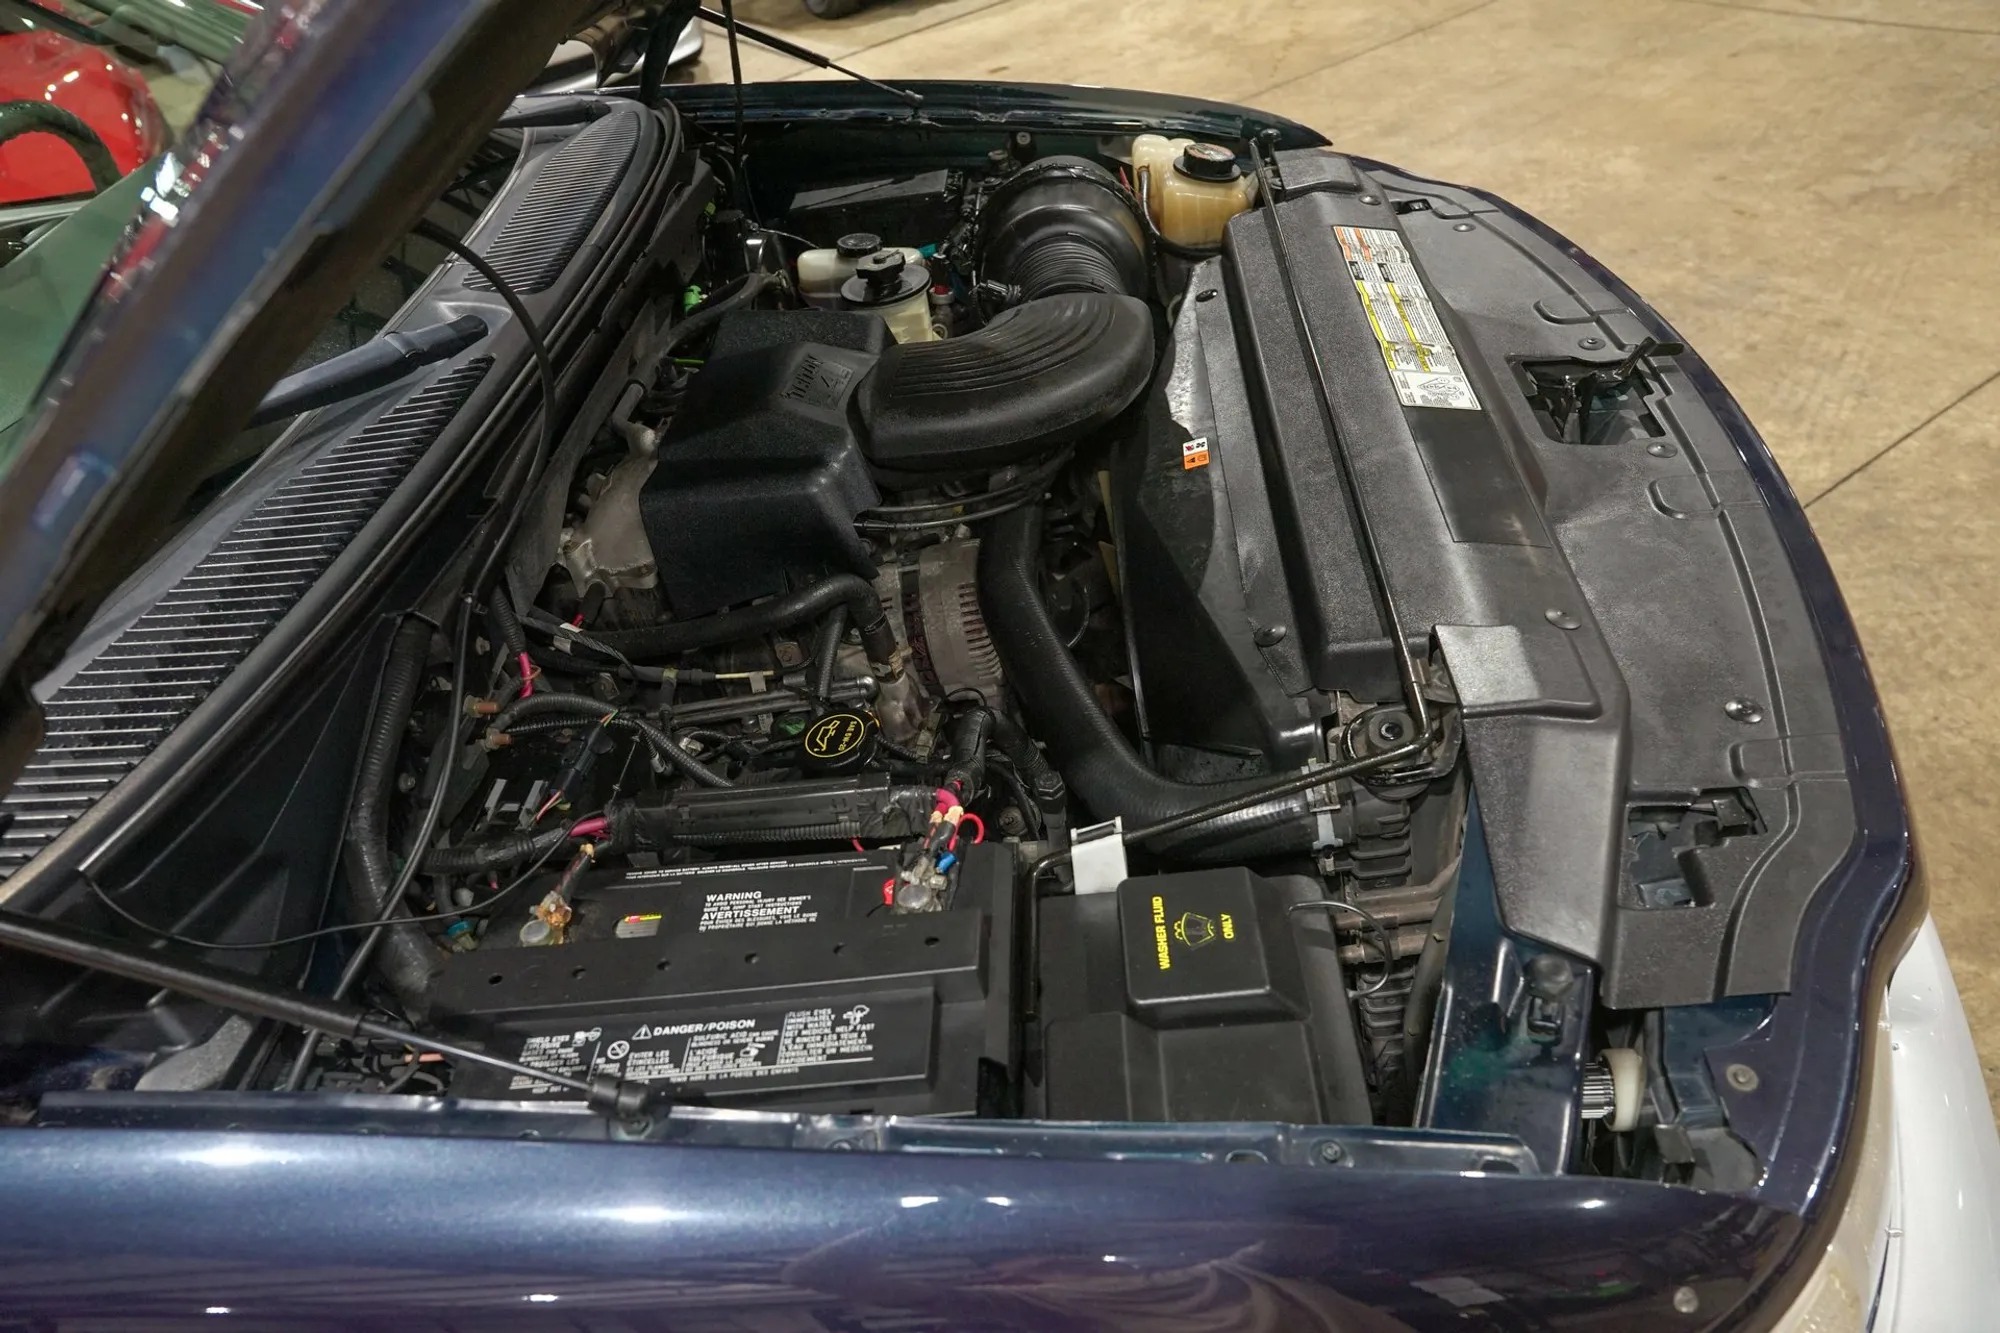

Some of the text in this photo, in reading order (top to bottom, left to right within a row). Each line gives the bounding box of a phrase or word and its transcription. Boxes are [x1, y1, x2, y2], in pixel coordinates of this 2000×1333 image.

[706, 891, 762, 902] WARNING
[701, 906, 800, 920] AVERTISSEMENT
[1152, 896, 1170, 970] WASHER FLUID
[1220, 913, 1234, 939] ONLY
[653, 1019, 756, 1036] DANGER/POISON
